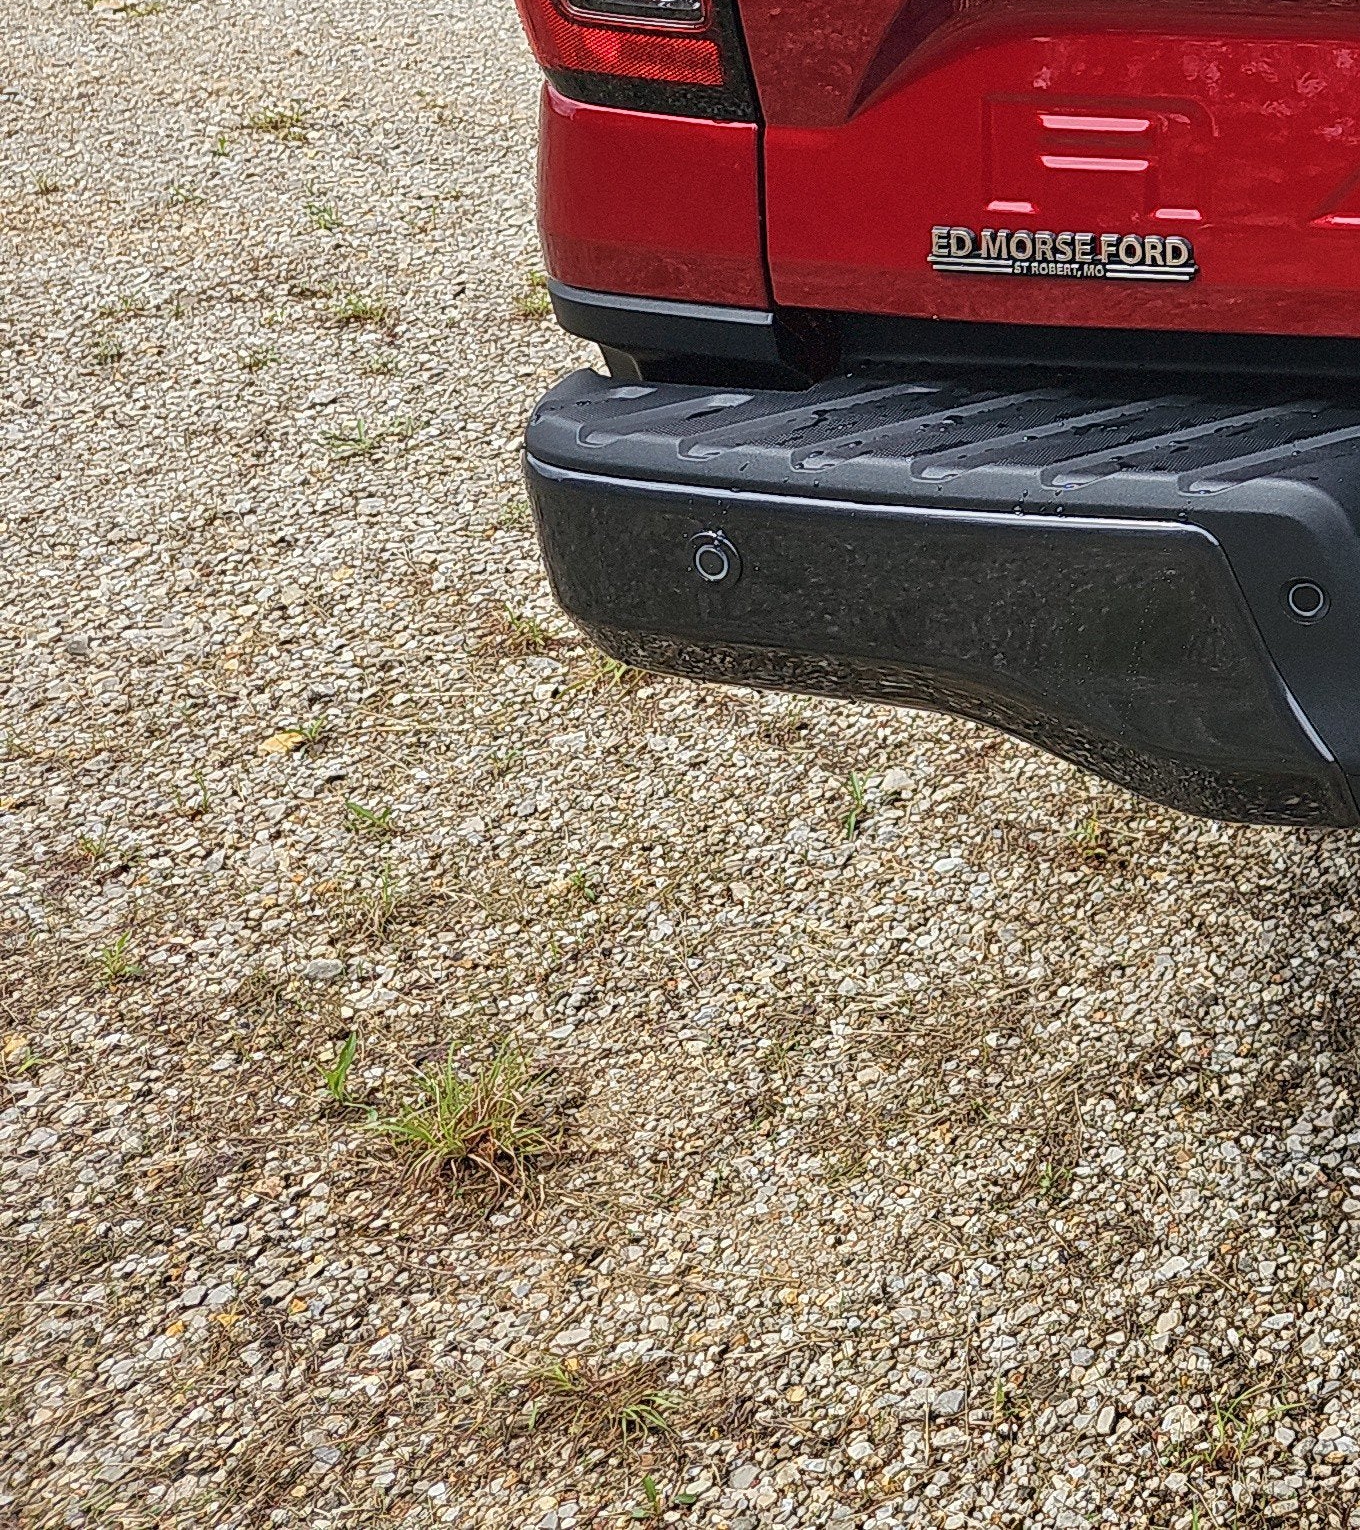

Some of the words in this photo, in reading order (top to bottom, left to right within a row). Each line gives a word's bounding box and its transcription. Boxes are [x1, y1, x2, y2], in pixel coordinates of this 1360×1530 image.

[931, 226, 976, 258] ED
[979, 228, 1095, 263] MORSE
[1099, 233, 1194, 266] FORD
[1031, 261, 1081, 277] ROBERT,
[1083, 263, 1104, 277] MO
